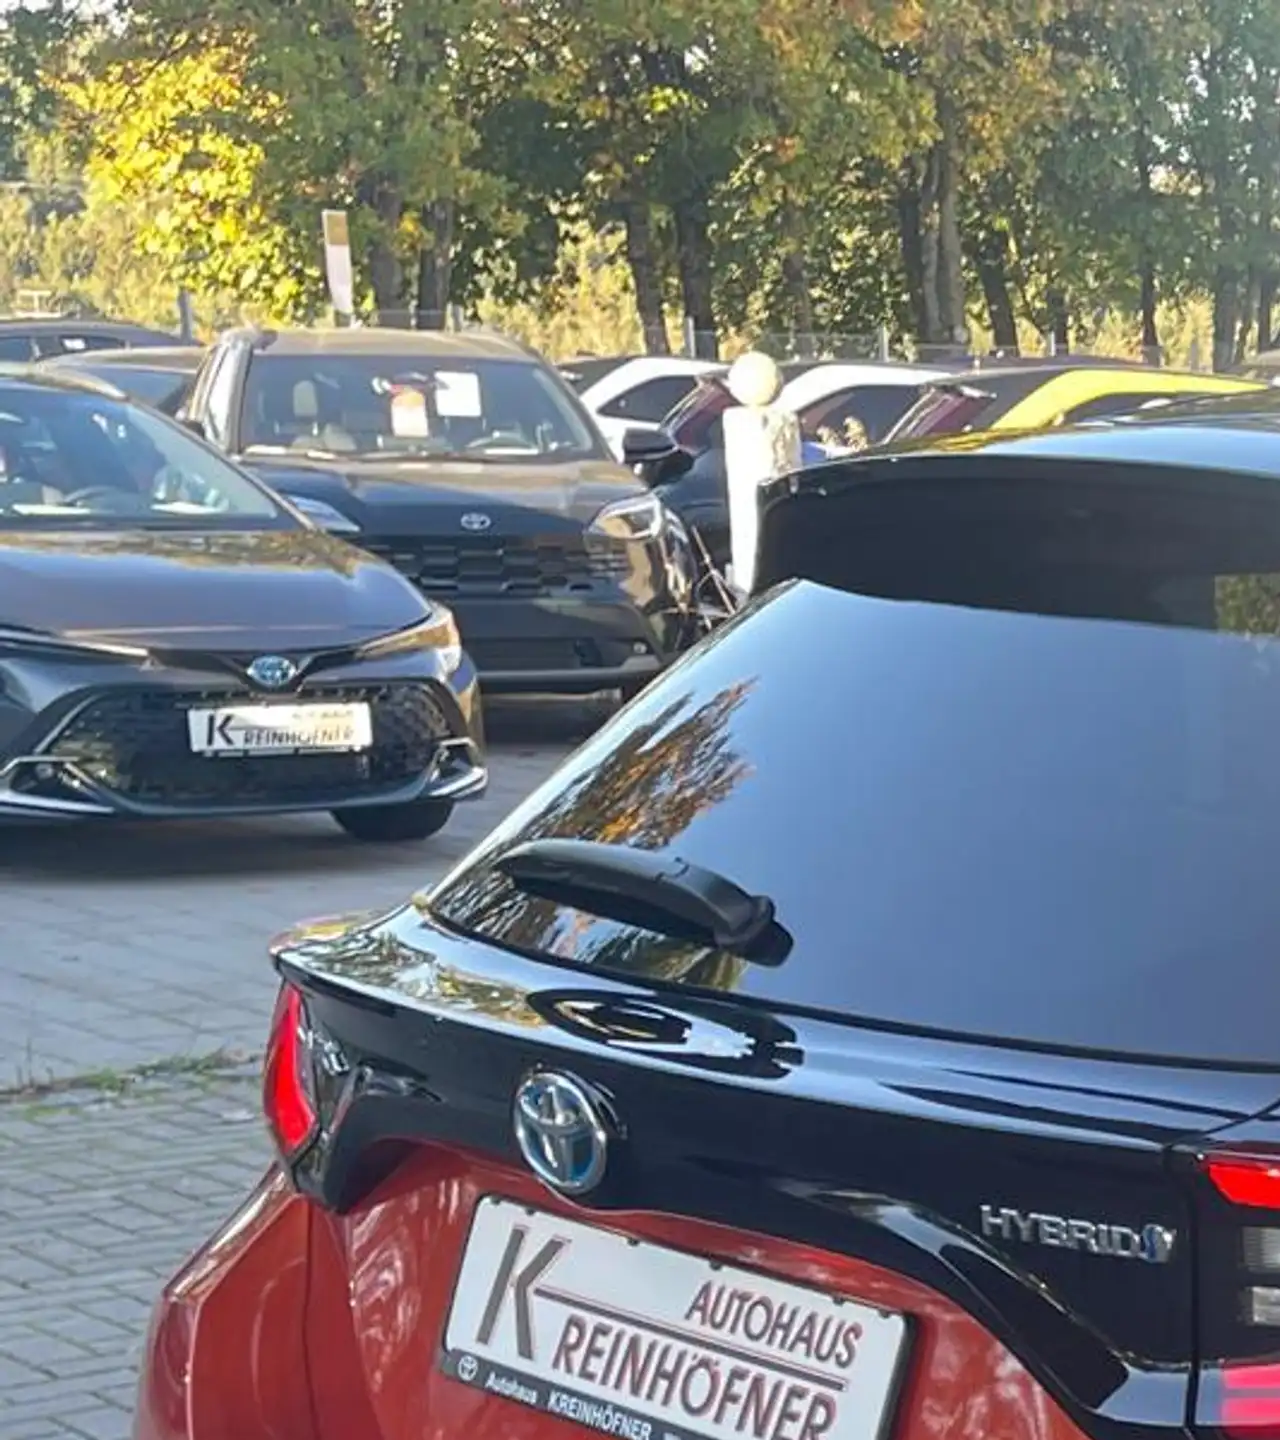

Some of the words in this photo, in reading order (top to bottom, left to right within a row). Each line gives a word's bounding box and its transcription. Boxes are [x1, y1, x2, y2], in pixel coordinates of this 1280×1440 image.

[980, 1204, 1140, 1258] HYBRID
[686, 1280, 863, 1369] AUTOHAUS
[485, 1371, 538, 1405] Autohaus
